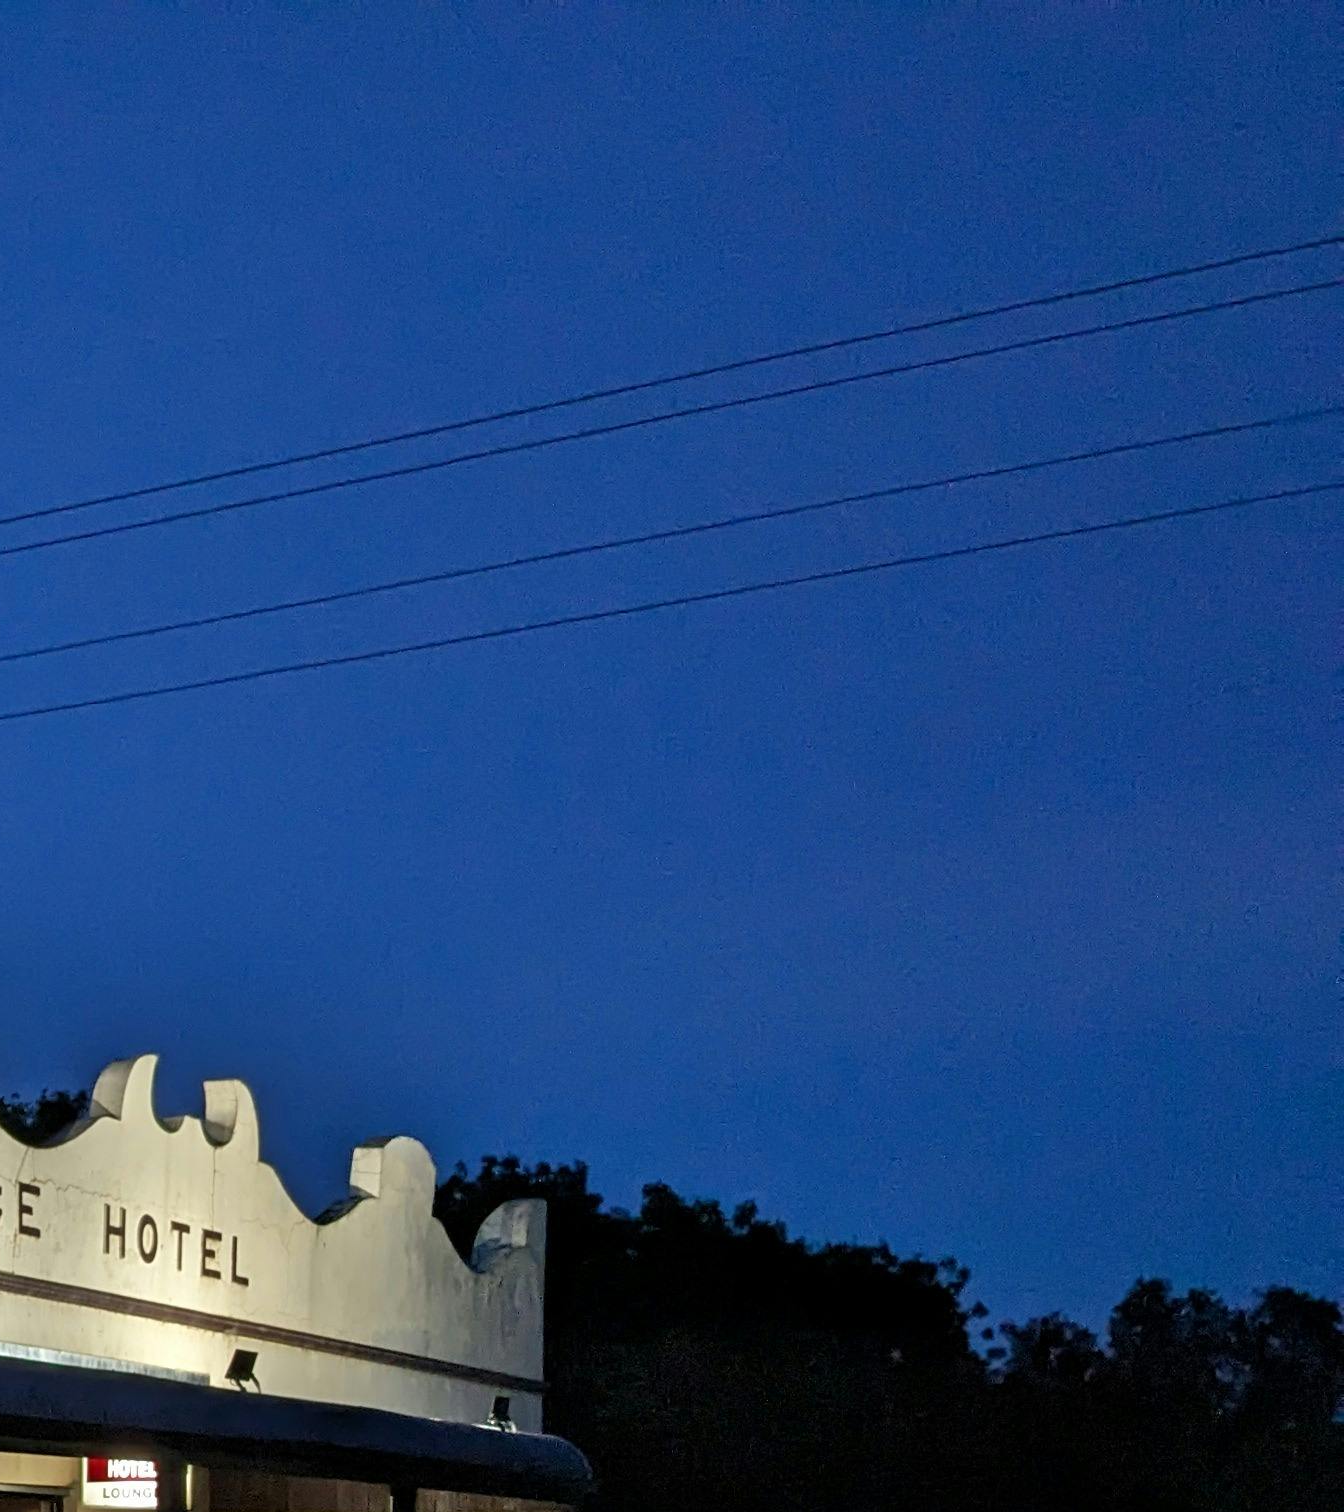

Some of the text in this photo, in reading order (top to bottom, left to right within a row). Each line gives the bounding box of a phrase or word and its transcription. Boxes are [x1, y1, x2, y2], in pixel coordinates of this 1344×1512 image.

[102, 1202, 250, 1288] HOTEL
[107, 1459, 158, 1479] HOTEL
[102, 1487, 156, 1499] LOUNG
